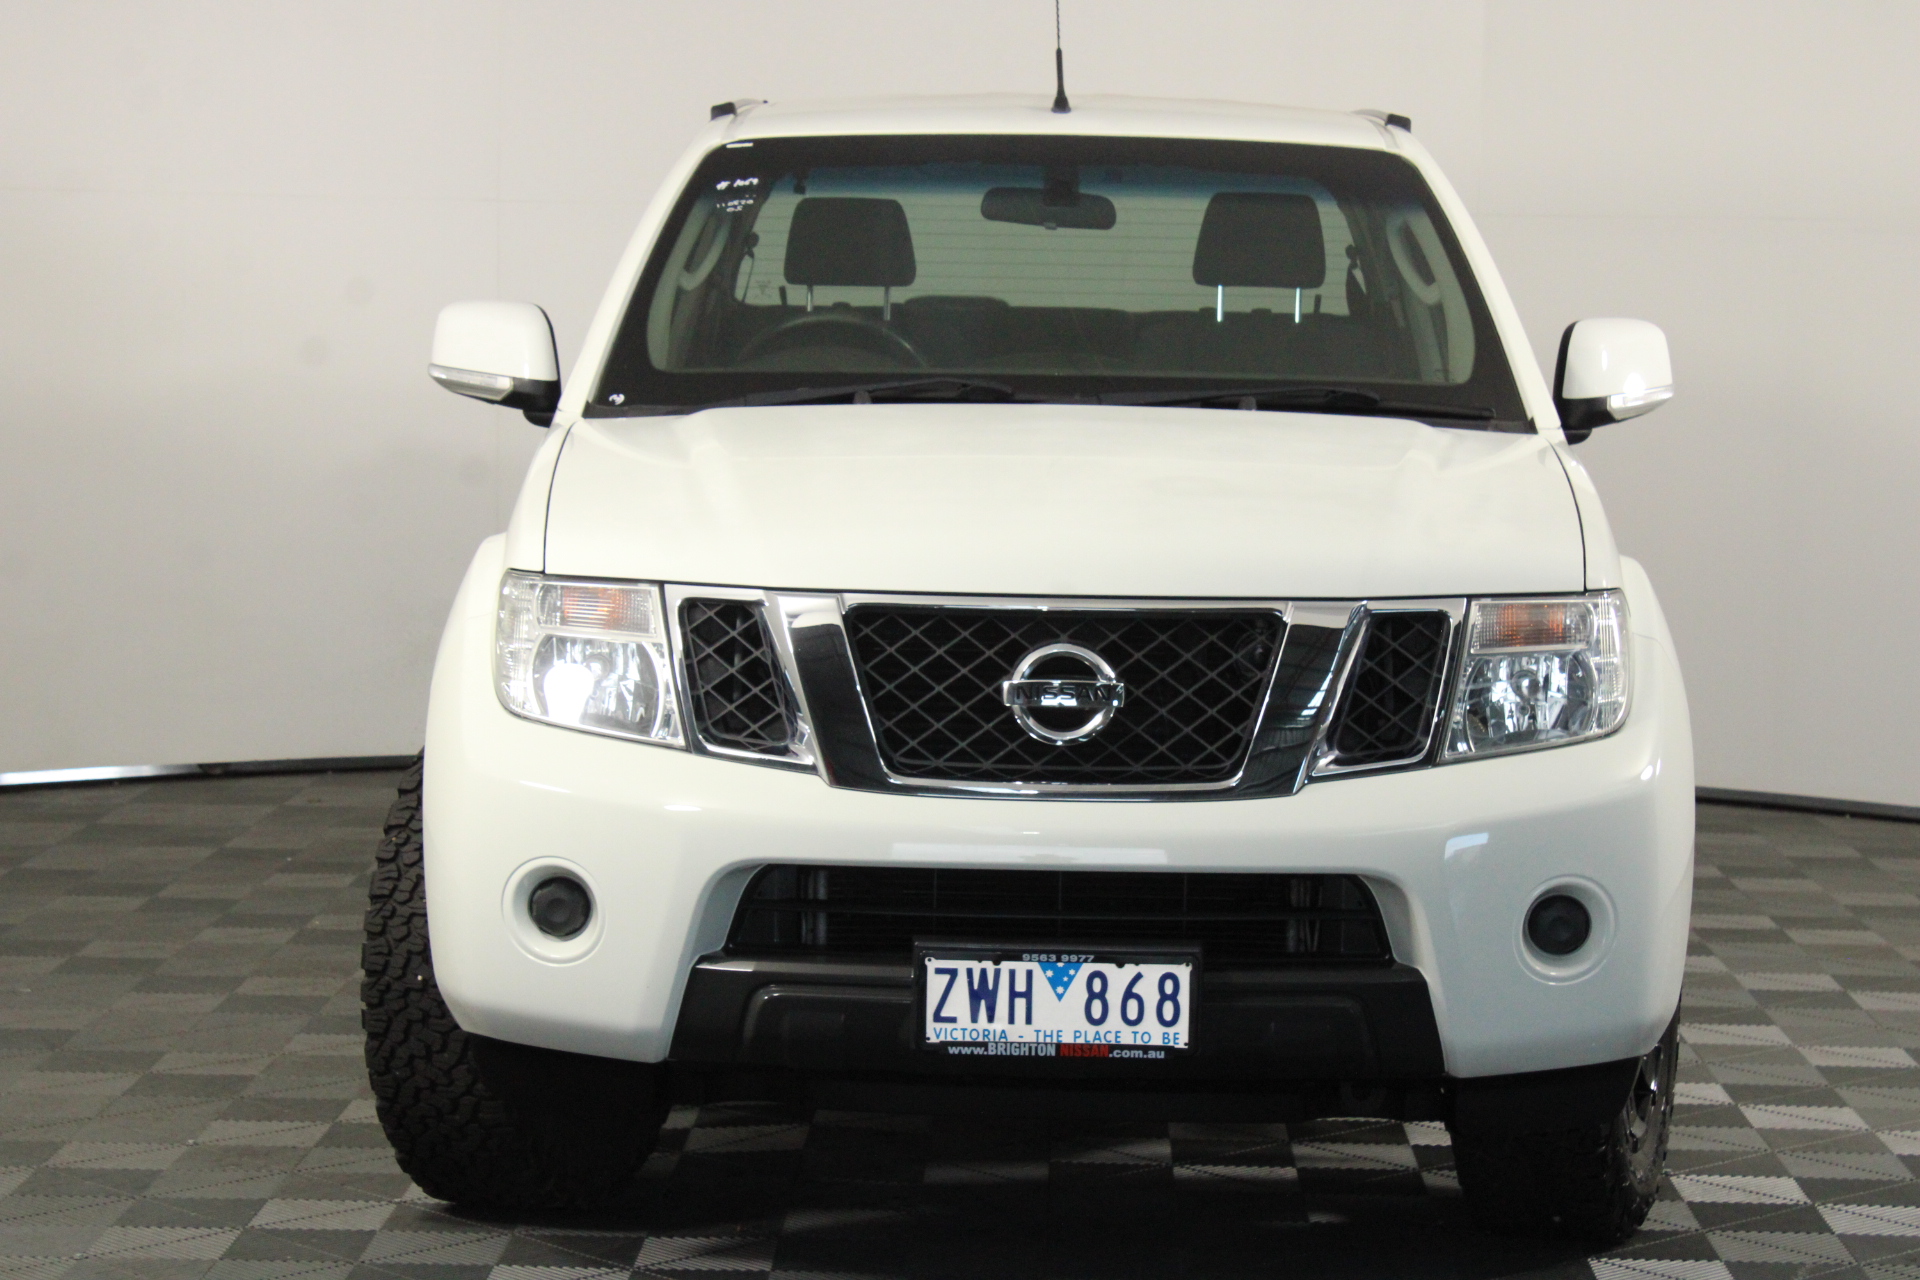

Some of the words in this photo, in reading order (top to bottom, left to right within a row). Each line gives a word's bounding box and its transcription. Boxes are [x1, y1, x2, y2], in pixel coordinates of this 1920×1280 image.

[1016, 684, 1112, 701] NISSAN
[1022, 953, 1056, 962] 9563
[1061, 954, 1094, 962] 9977
[933, 967, 1033, 1025] ZWH
[1084, 970, 1180, 1027] 868
[933, 1027, 1008, 1042] VICTORIA
[1034, 1029, 1063, 1043] THE
[1074, 1030, 1121, 1043] PLACE
[1131, 1031, 1151, 1044] TO
[1162, 1032, 1180, 1045] BE
